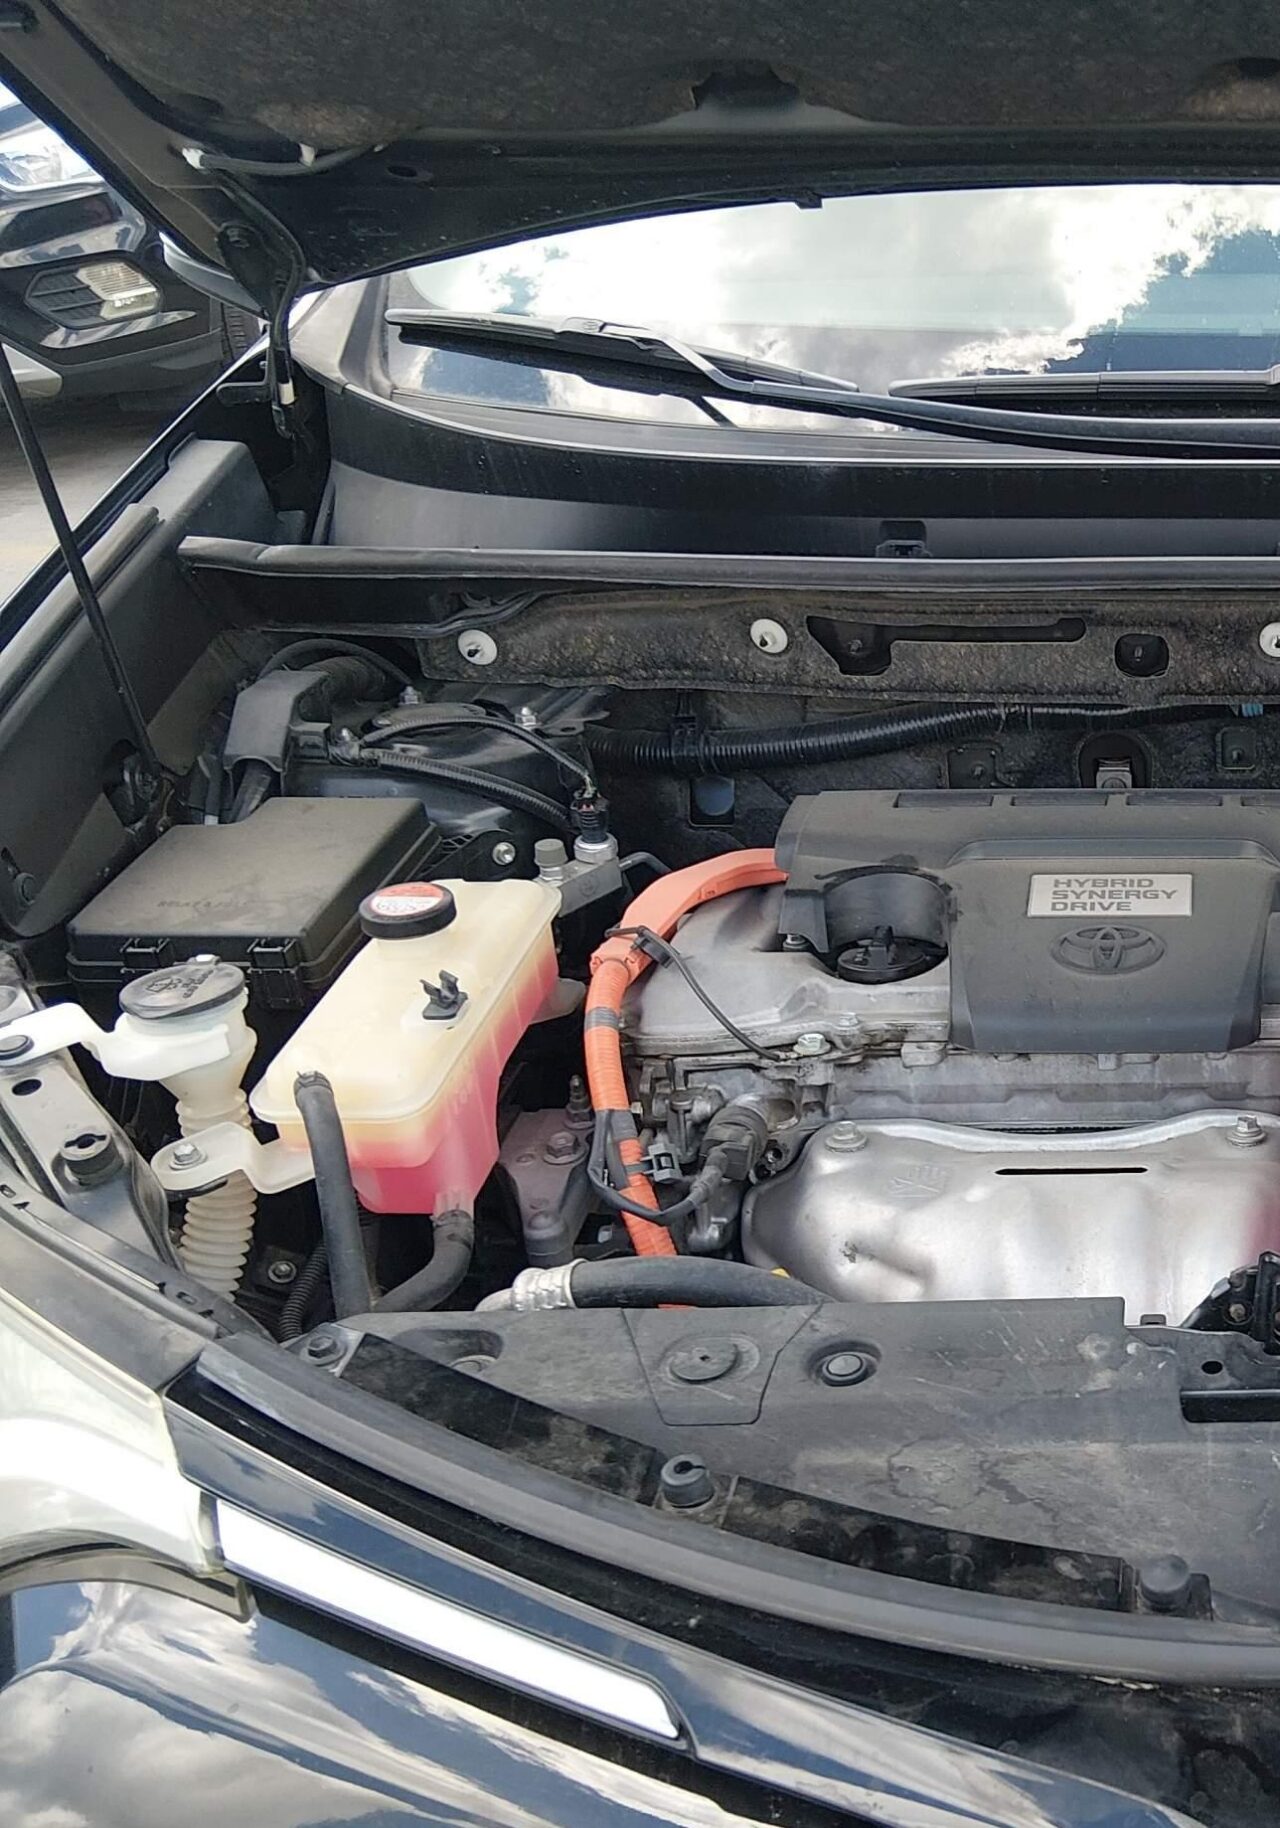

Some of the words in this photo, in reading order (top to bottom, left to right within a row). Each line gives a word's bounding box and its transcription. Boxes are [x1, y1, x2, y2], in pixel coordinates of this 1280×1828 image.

[1053, 878, 1154, 888] HYBRID
[1051, 889, 1178, 900] SYNERGY
[1050, 901, 1133, 912] DRIVE
